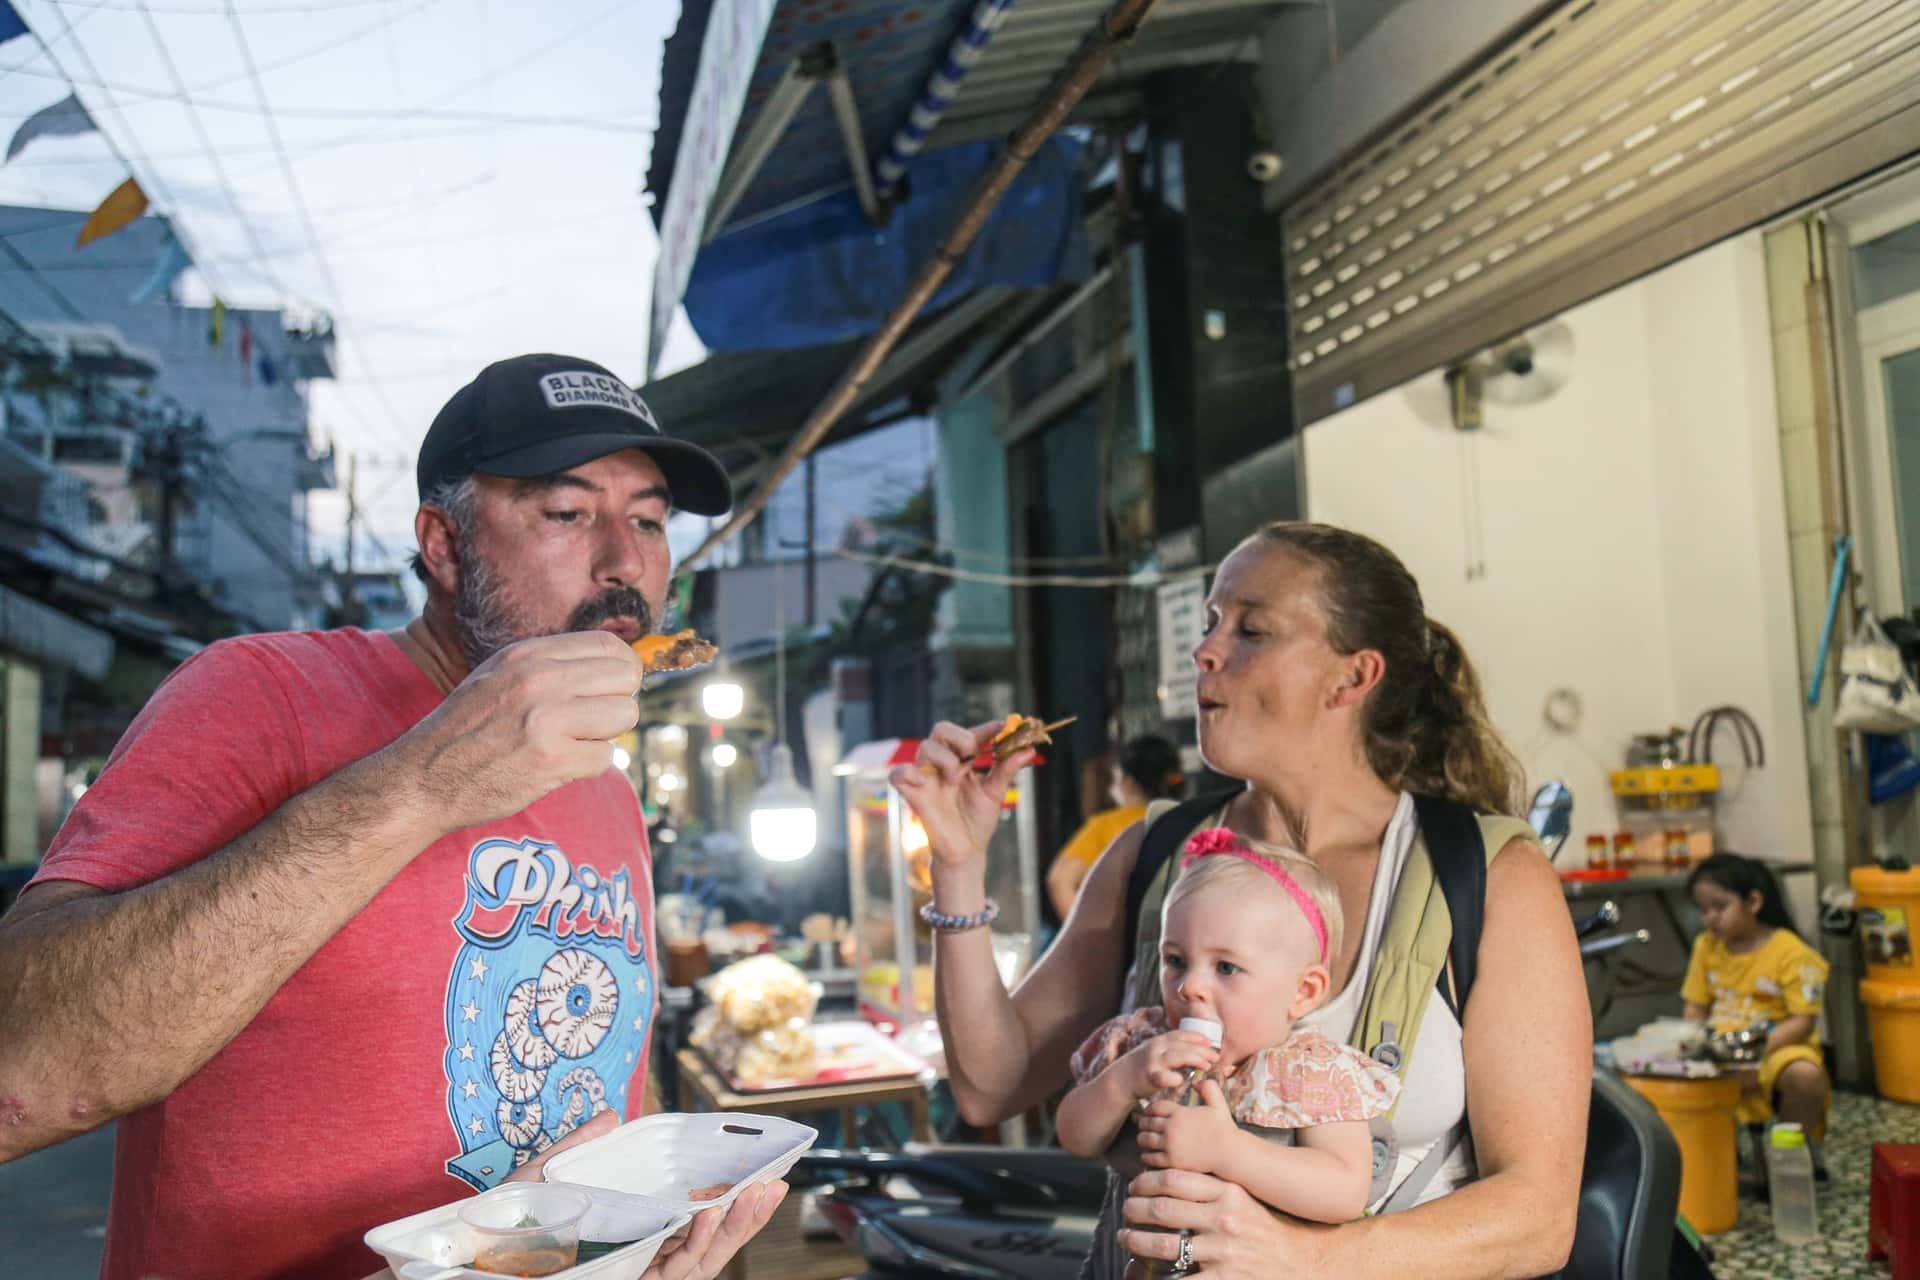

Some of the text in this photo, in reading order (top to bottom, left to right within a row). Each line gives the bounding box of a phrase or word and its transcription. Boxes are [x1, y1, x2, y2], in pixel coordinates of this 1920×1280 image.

[547, 375, 625, 396] BLACK
[553, 391, 630, 408] DIAMOND
[461, 842, 642, 957] Phish
